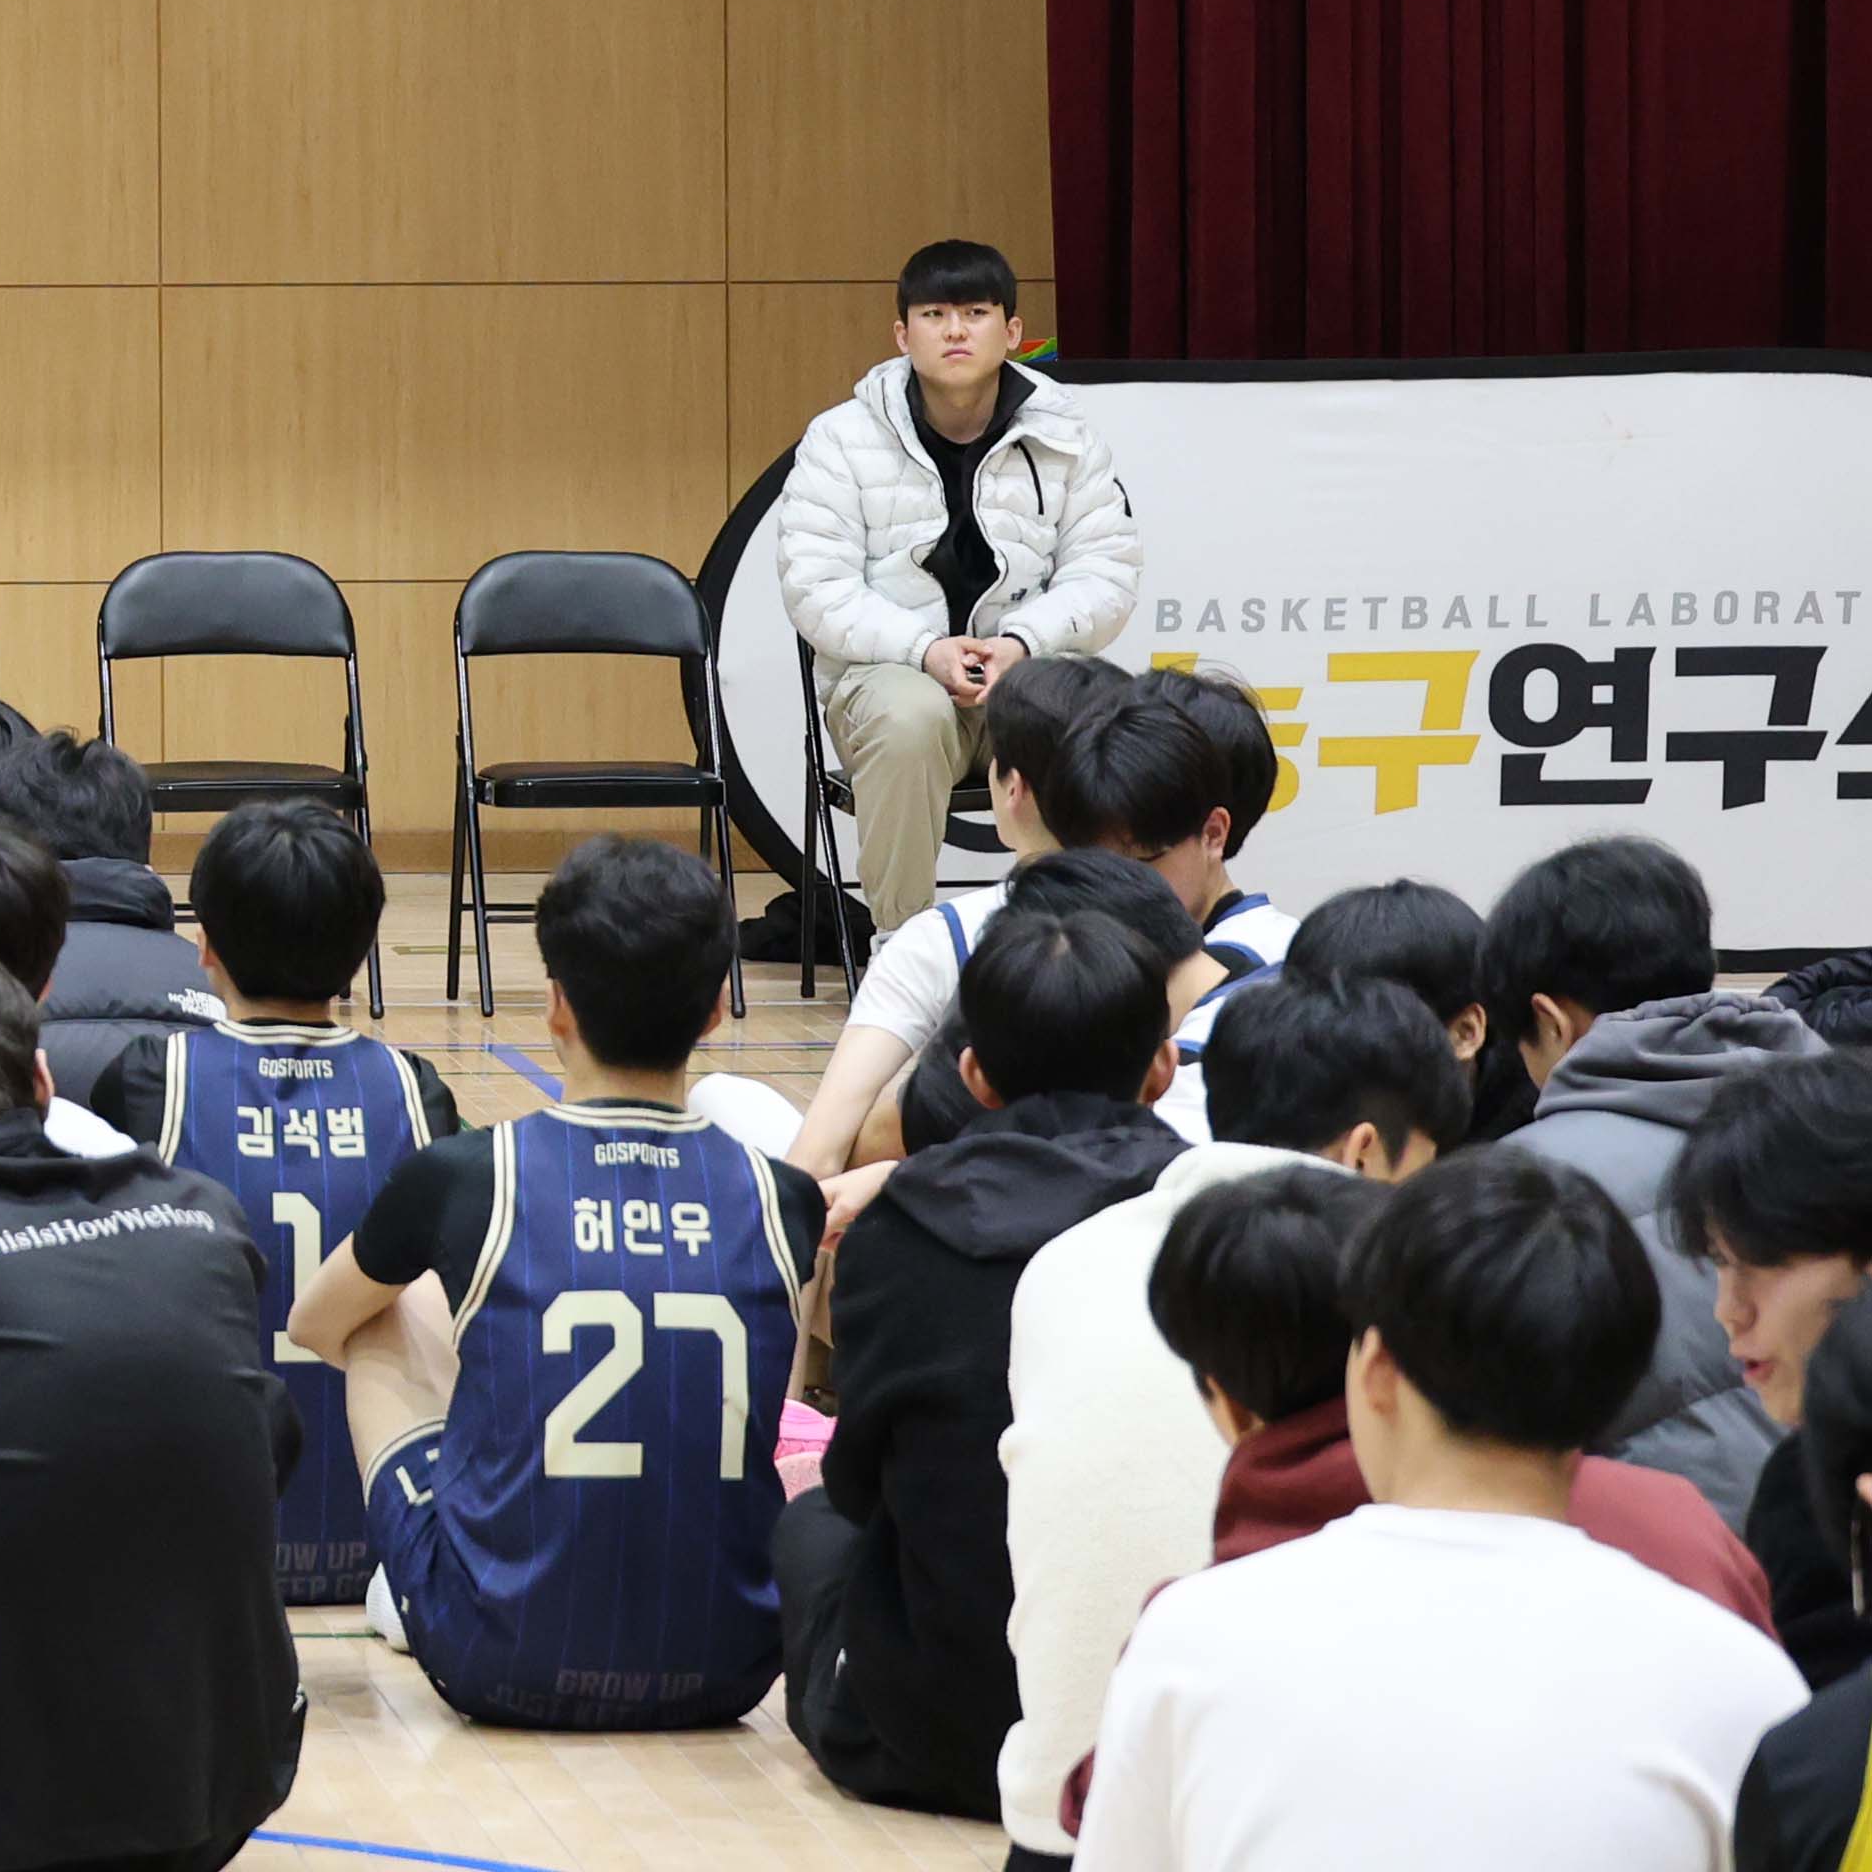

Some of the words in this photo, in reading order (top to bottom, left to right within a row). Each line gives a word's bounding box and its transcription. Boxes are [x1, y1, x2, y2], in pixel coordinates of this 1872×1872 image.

[1153, 594, 1550, 633] BASKETBALL
[1587, 589, 1863, 628] LABORAT
[1150, 642, 1872, 815] 구연구
[258, 1058, 334, 1079] GOSPORTS
[236, 1105, 366, 1160] 김석범
[594, 1141, 681, 1169] GOSPORTS
[573, 1196, 712, 1257] 허인우
[541, 1289, 750, 1481] 27
